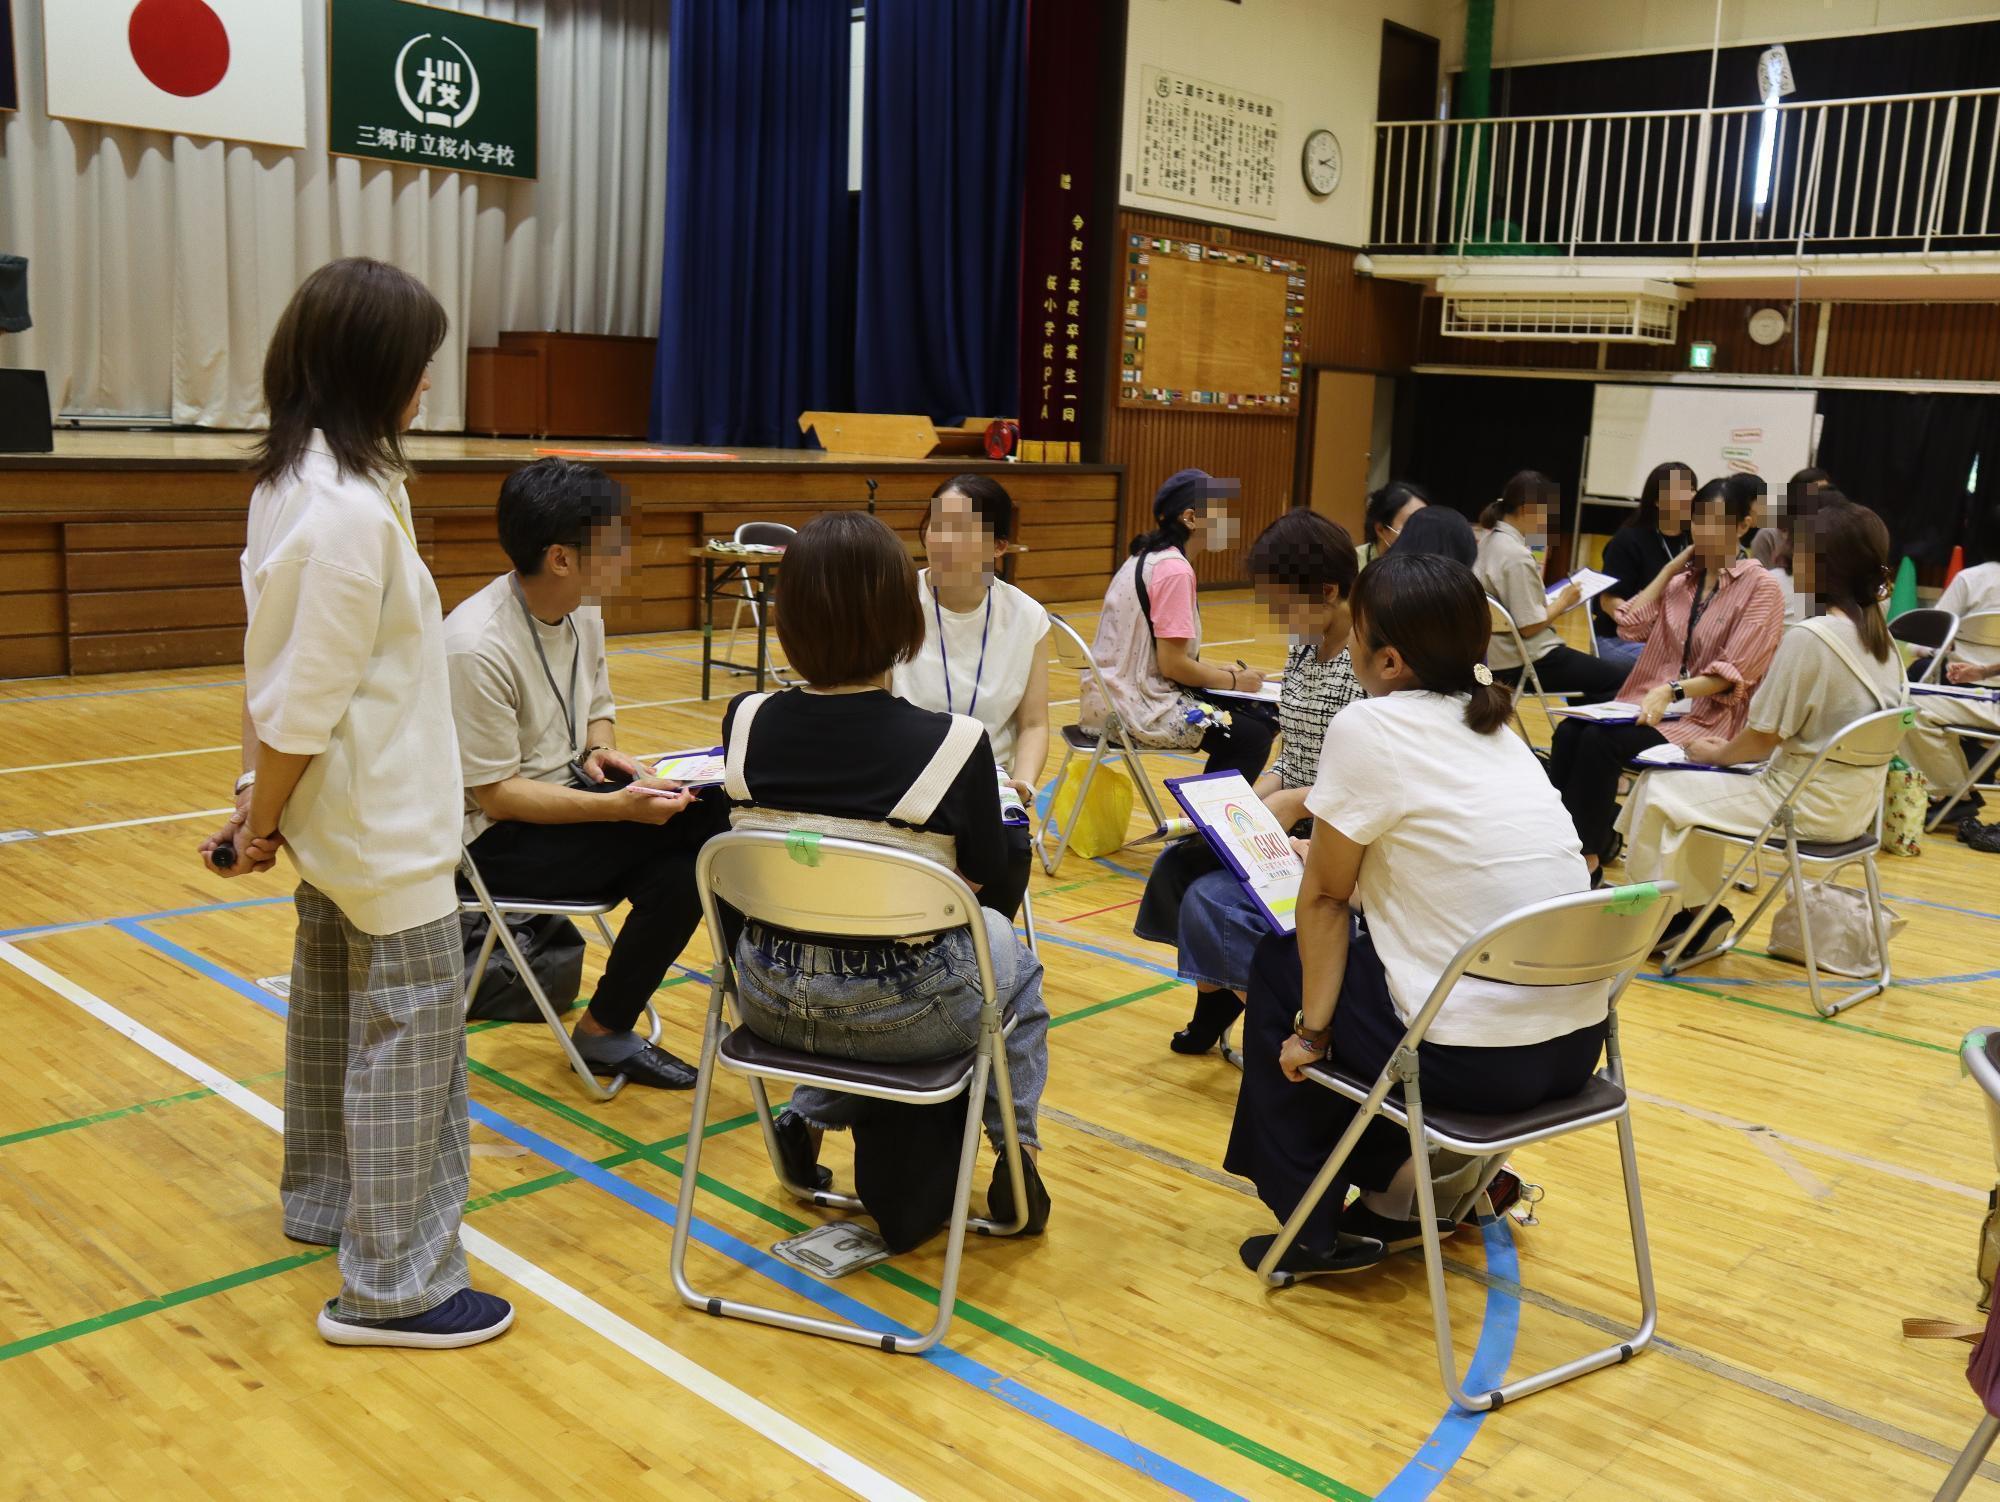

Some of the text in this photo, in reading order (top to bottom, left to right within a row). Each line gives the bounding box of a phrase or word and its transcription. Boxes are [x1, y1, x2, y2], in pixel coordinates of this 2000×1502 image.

[416, 57, 461, 110] 桜
[356, 125, 515, 167] 三郷市立桜小学校
[1062, 214, 1085, 422] 令和元年度卒業生一同
